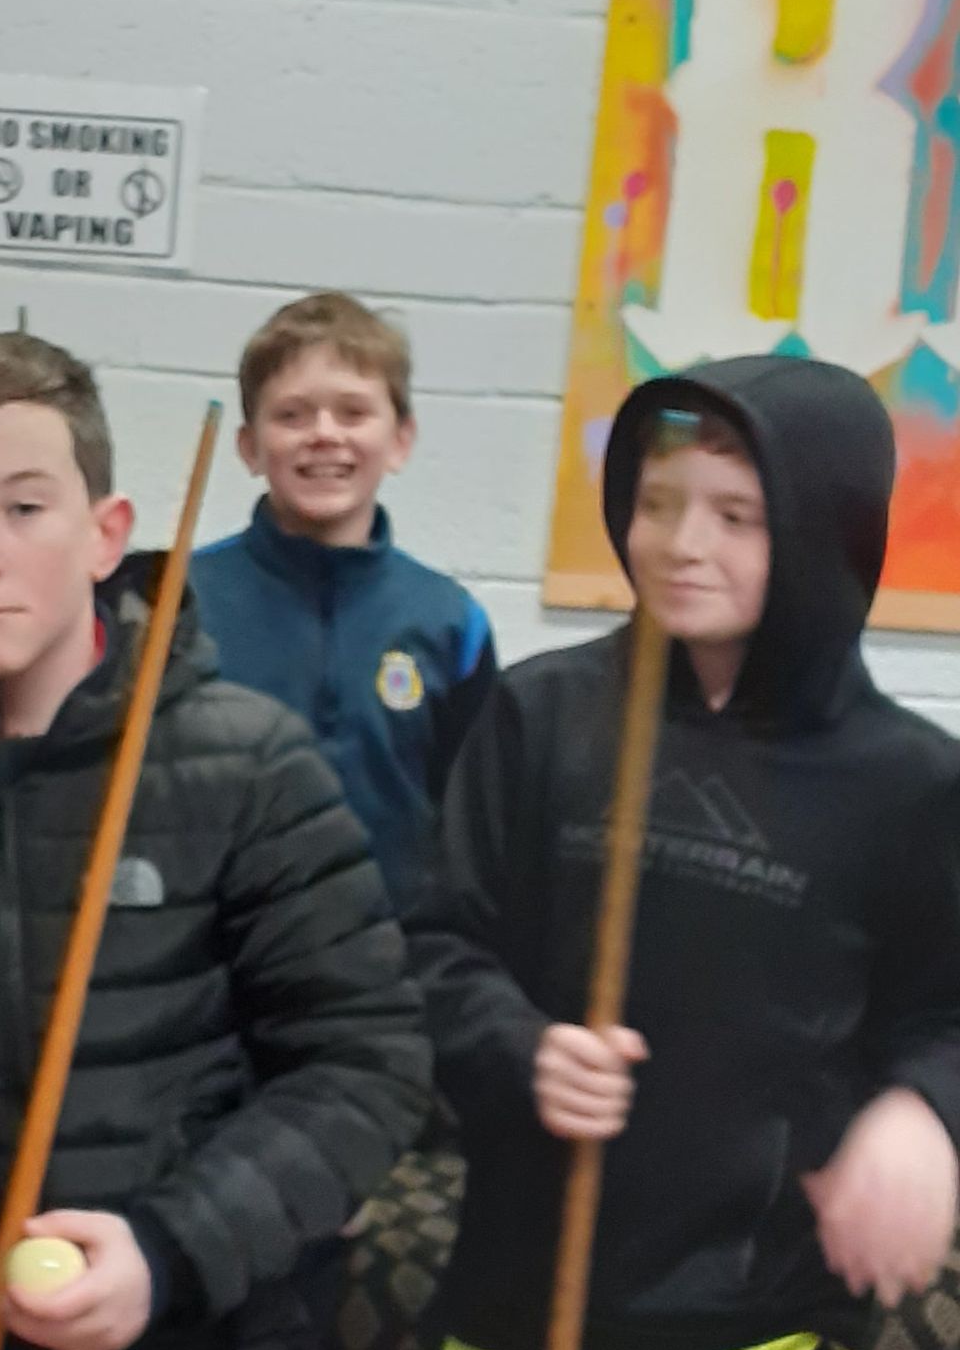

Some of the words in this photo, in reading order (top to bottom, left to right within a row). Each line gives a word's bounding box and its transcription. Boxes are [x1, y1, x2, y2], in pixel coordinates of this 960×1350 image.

[27, 121, 169, 157] SMOKING
[52, 167, 92, 198] OR
[5, 210, 135, 246] VAPING
[559, 822, 808, 893] MOTERRAIN
